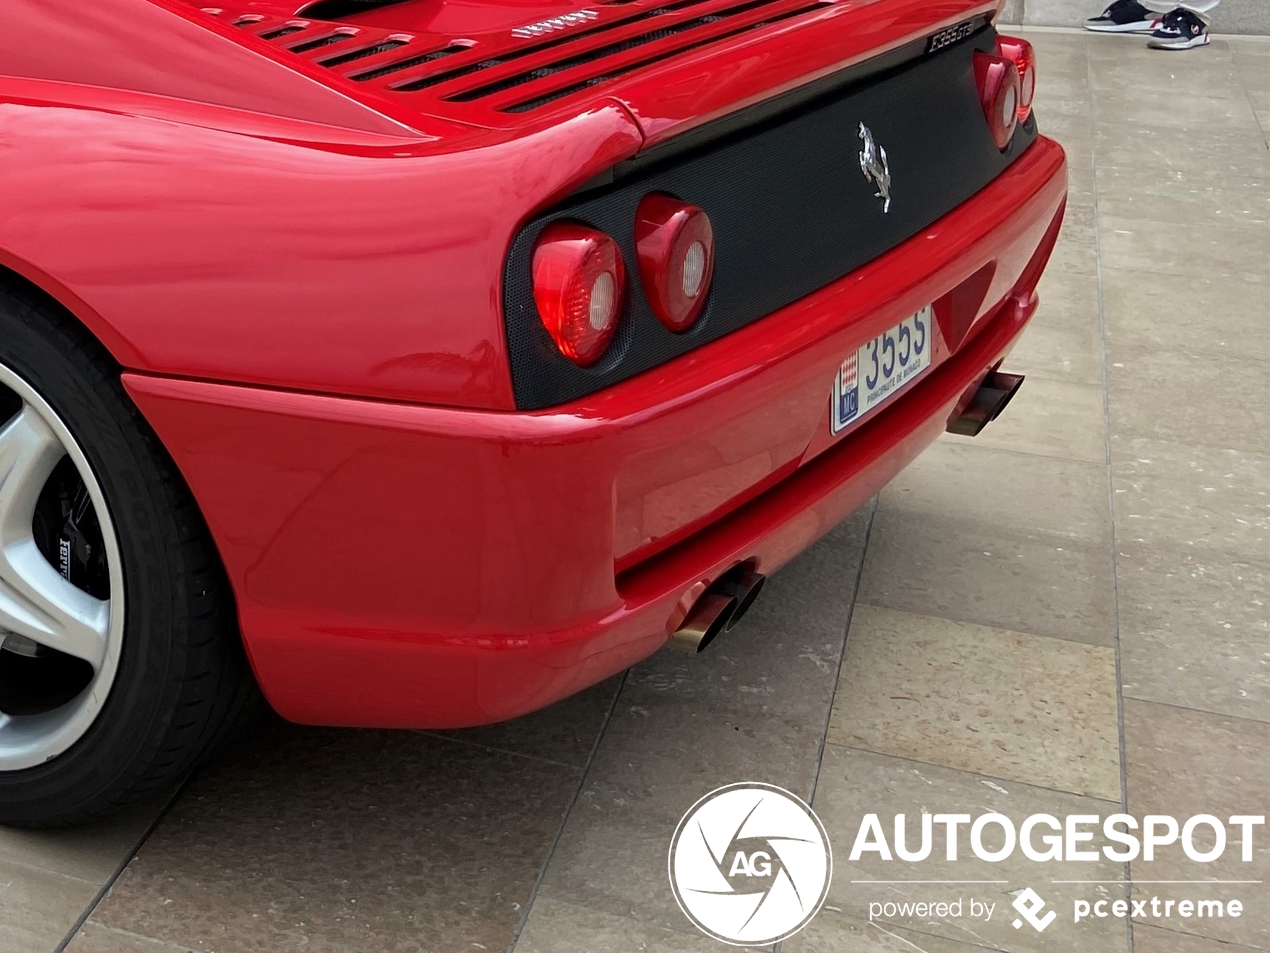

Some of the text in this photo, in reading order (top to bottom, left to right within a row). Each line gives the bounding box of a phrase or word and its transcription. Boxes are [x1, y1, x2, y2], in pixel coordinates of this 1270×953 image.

[865, 307, 925, 390] 3555
[896, 372, 903, 384] DE
[842, 391, 856, 416] MC
